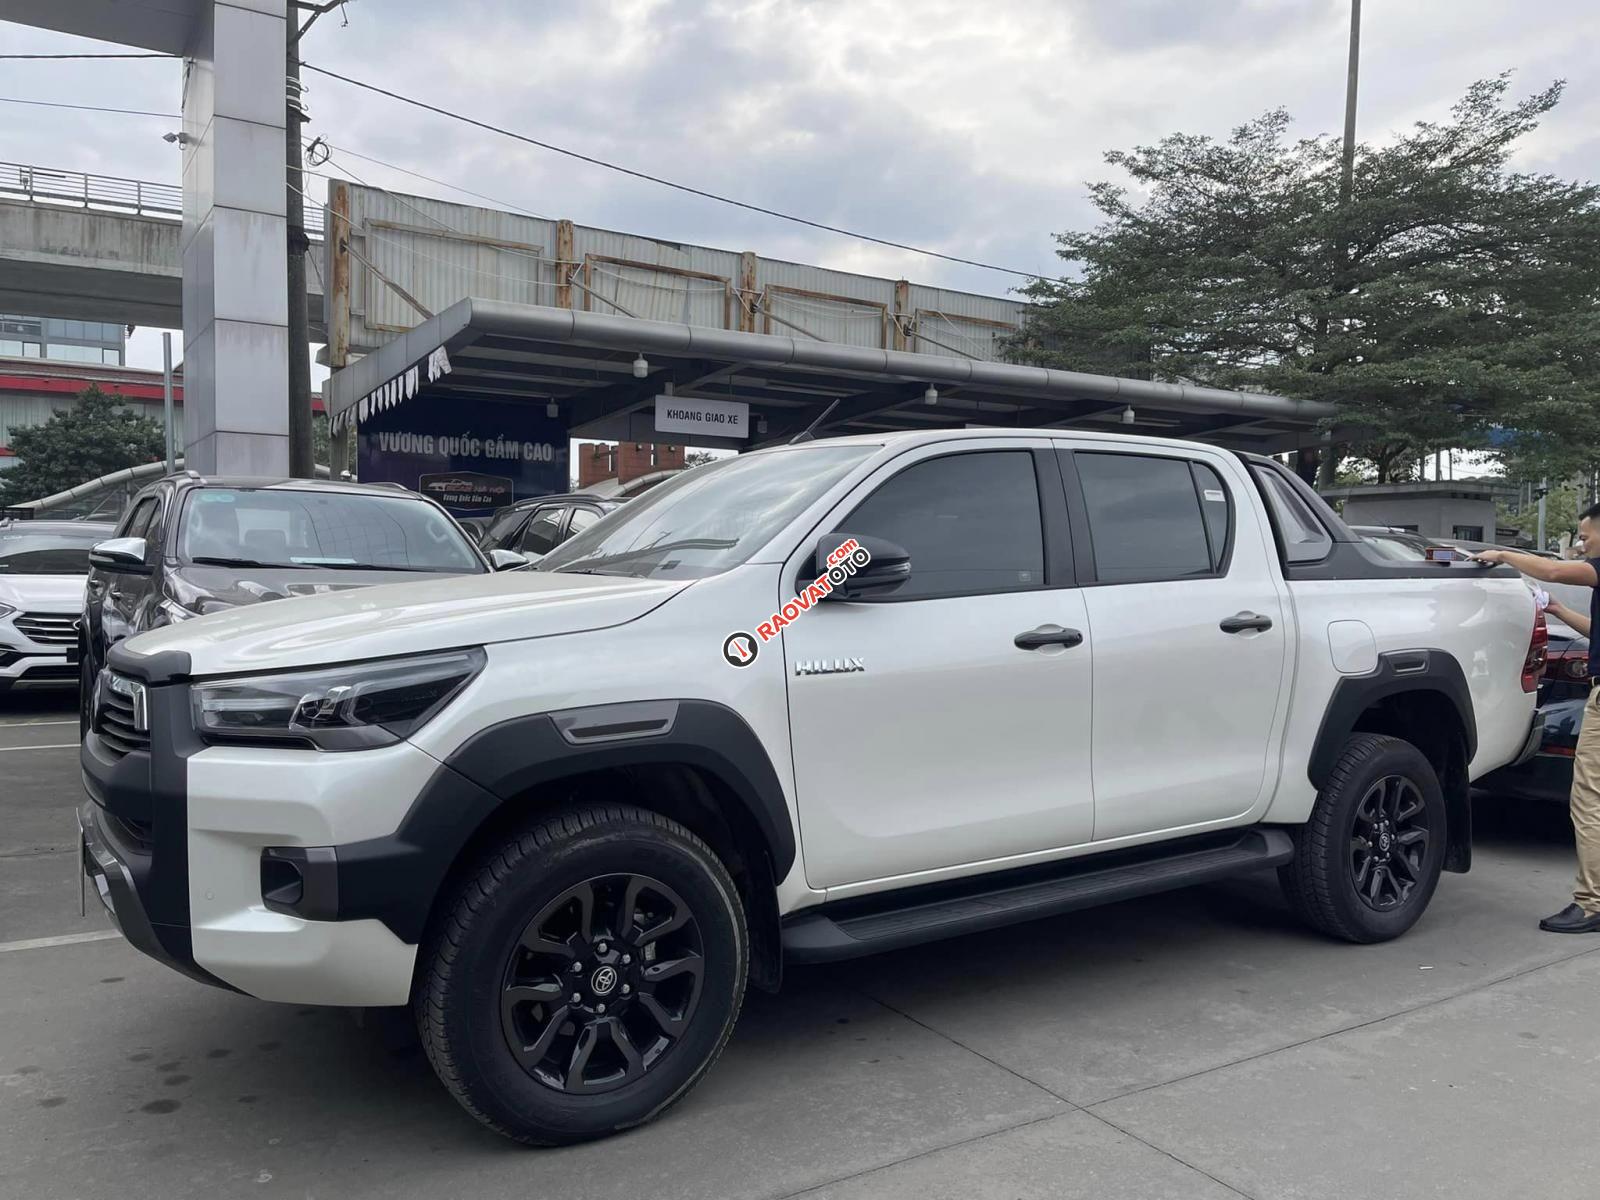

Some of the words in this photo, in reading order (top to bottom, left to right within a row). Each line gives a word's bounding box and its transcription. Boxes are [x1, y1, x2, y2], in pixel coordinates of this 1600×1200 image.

[667, 409, 702, 422] KHOANG
[705, 412, 725, 423] GIAO
[727, 415, 738, 424] XE
[379, 431, 434, 455] VƯƠNG
[438, 431, 480, 457] QUỐC
[523, 442, 552, 462] CAO
[795, 657, 865, 676] HILUX
